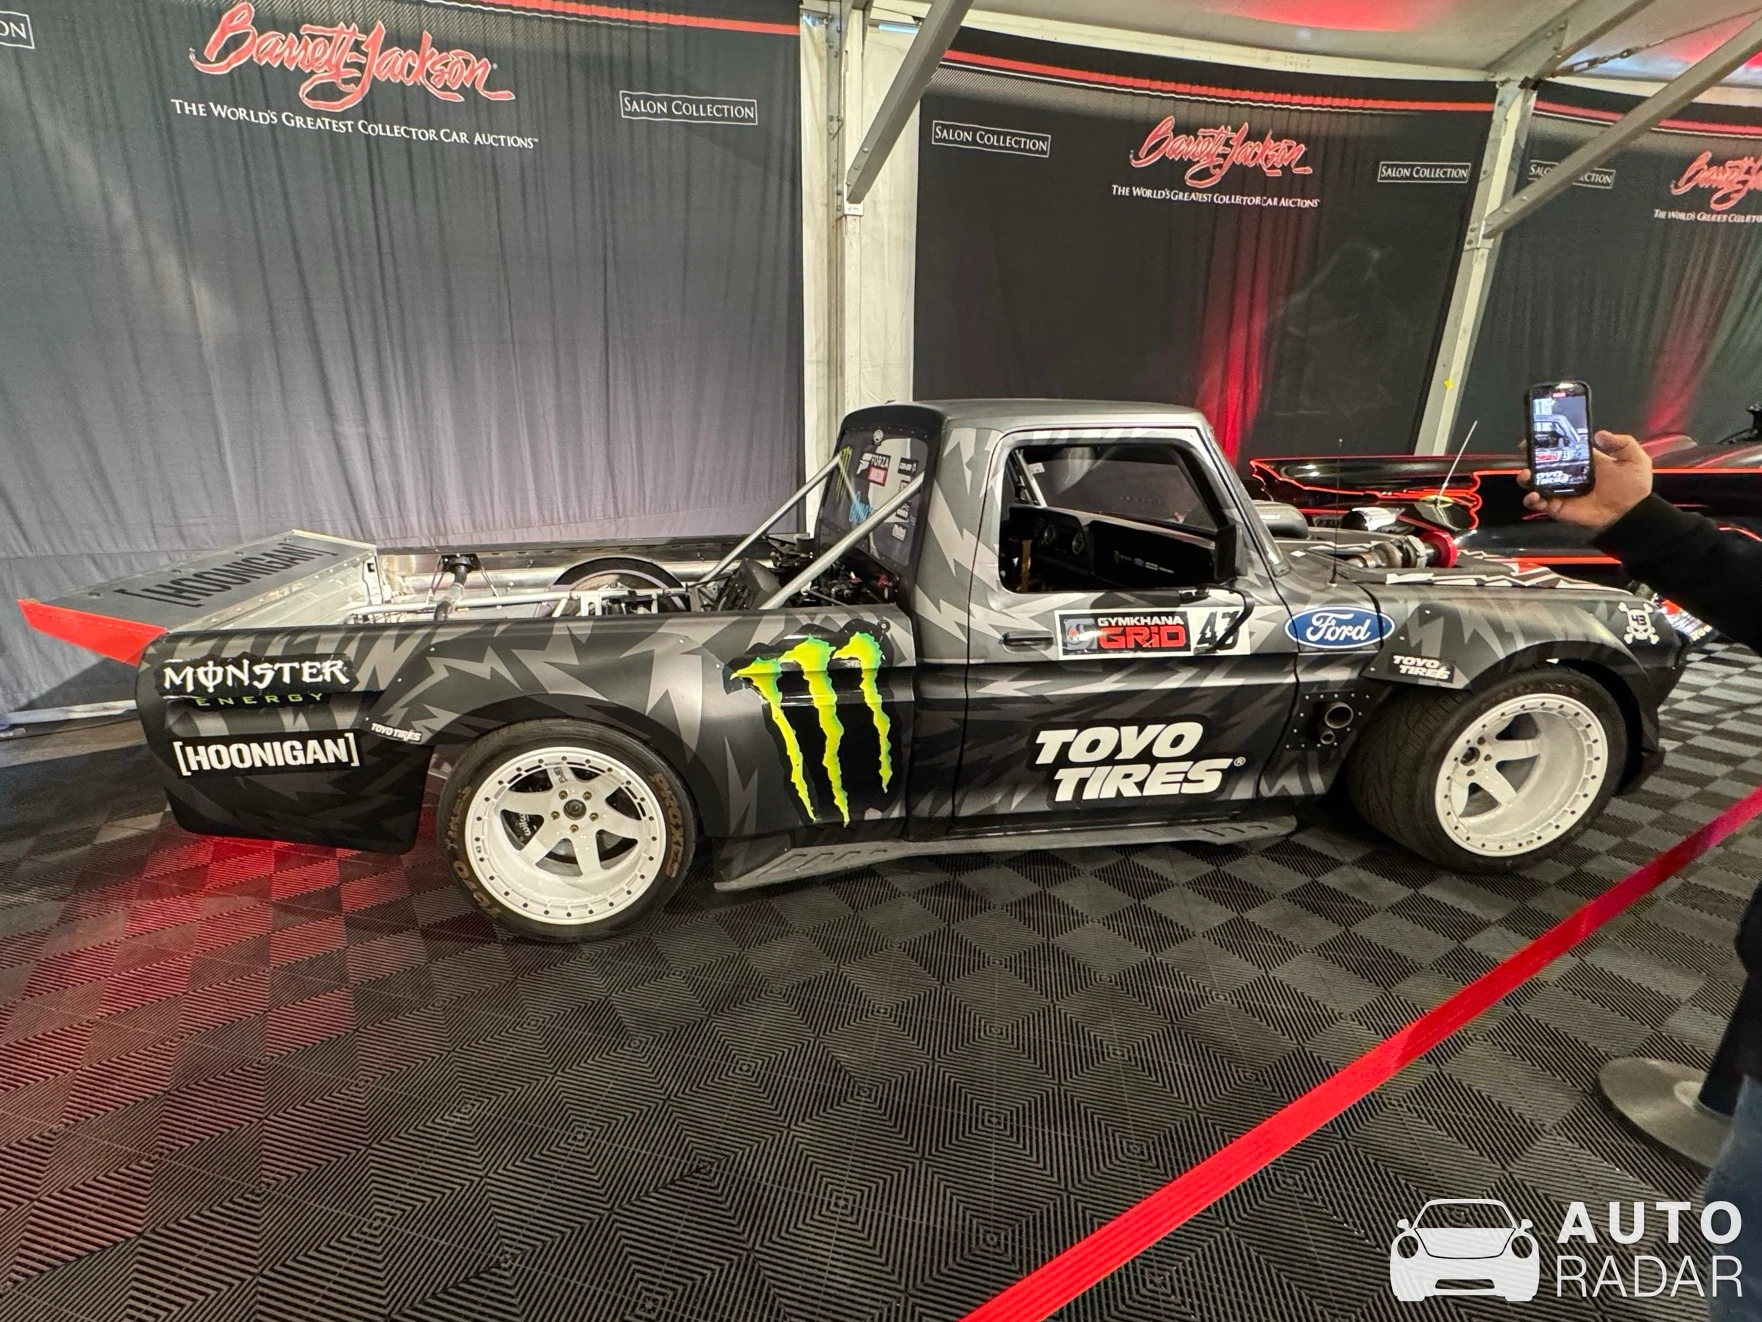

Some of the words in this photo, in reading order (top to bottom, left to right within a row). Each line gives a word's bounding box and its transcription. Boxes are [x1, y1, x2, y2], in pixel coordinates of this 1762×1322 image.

[624, 97, 668, 114] SALON
[671, 101, 754, 118] COLLECTION
[171, 99, 207, 116] THE
[209, 102, 277, 124] WORLD'S
[281, 112, 354, 133] GREATEST
[358, 120, 438, 141] COLLECTOR
[440, 129, 470, 144] CAR
[935, 126, 972, 142] SALON
[976, 131, 1048, 151] COLLECTION
[1381, 166, 1411, 178] SALON
[1412, 166, 1468, 179] COLLECTION
[1111, 185, 1130, 196] THE
[1132, 186, 1170, 200] WORLD'S
[1171, 190, 1212, 203] GREATEST
[1097, 616, 1184, 627] GYMKHANA
[1306, 612, 1371, 641] Ford
[1393, 655, 1440, 668] TOYO
[163, 659, 350, 693] MONSTER
[1399, 665, 1450, 679] TIRES
[196, 693, 323, 707] ENERGY
[371, 722, 393, 736] TOYO
[393, 729, 421, 741] TIRES
[1035, 722, 1203, 764] TOYO
